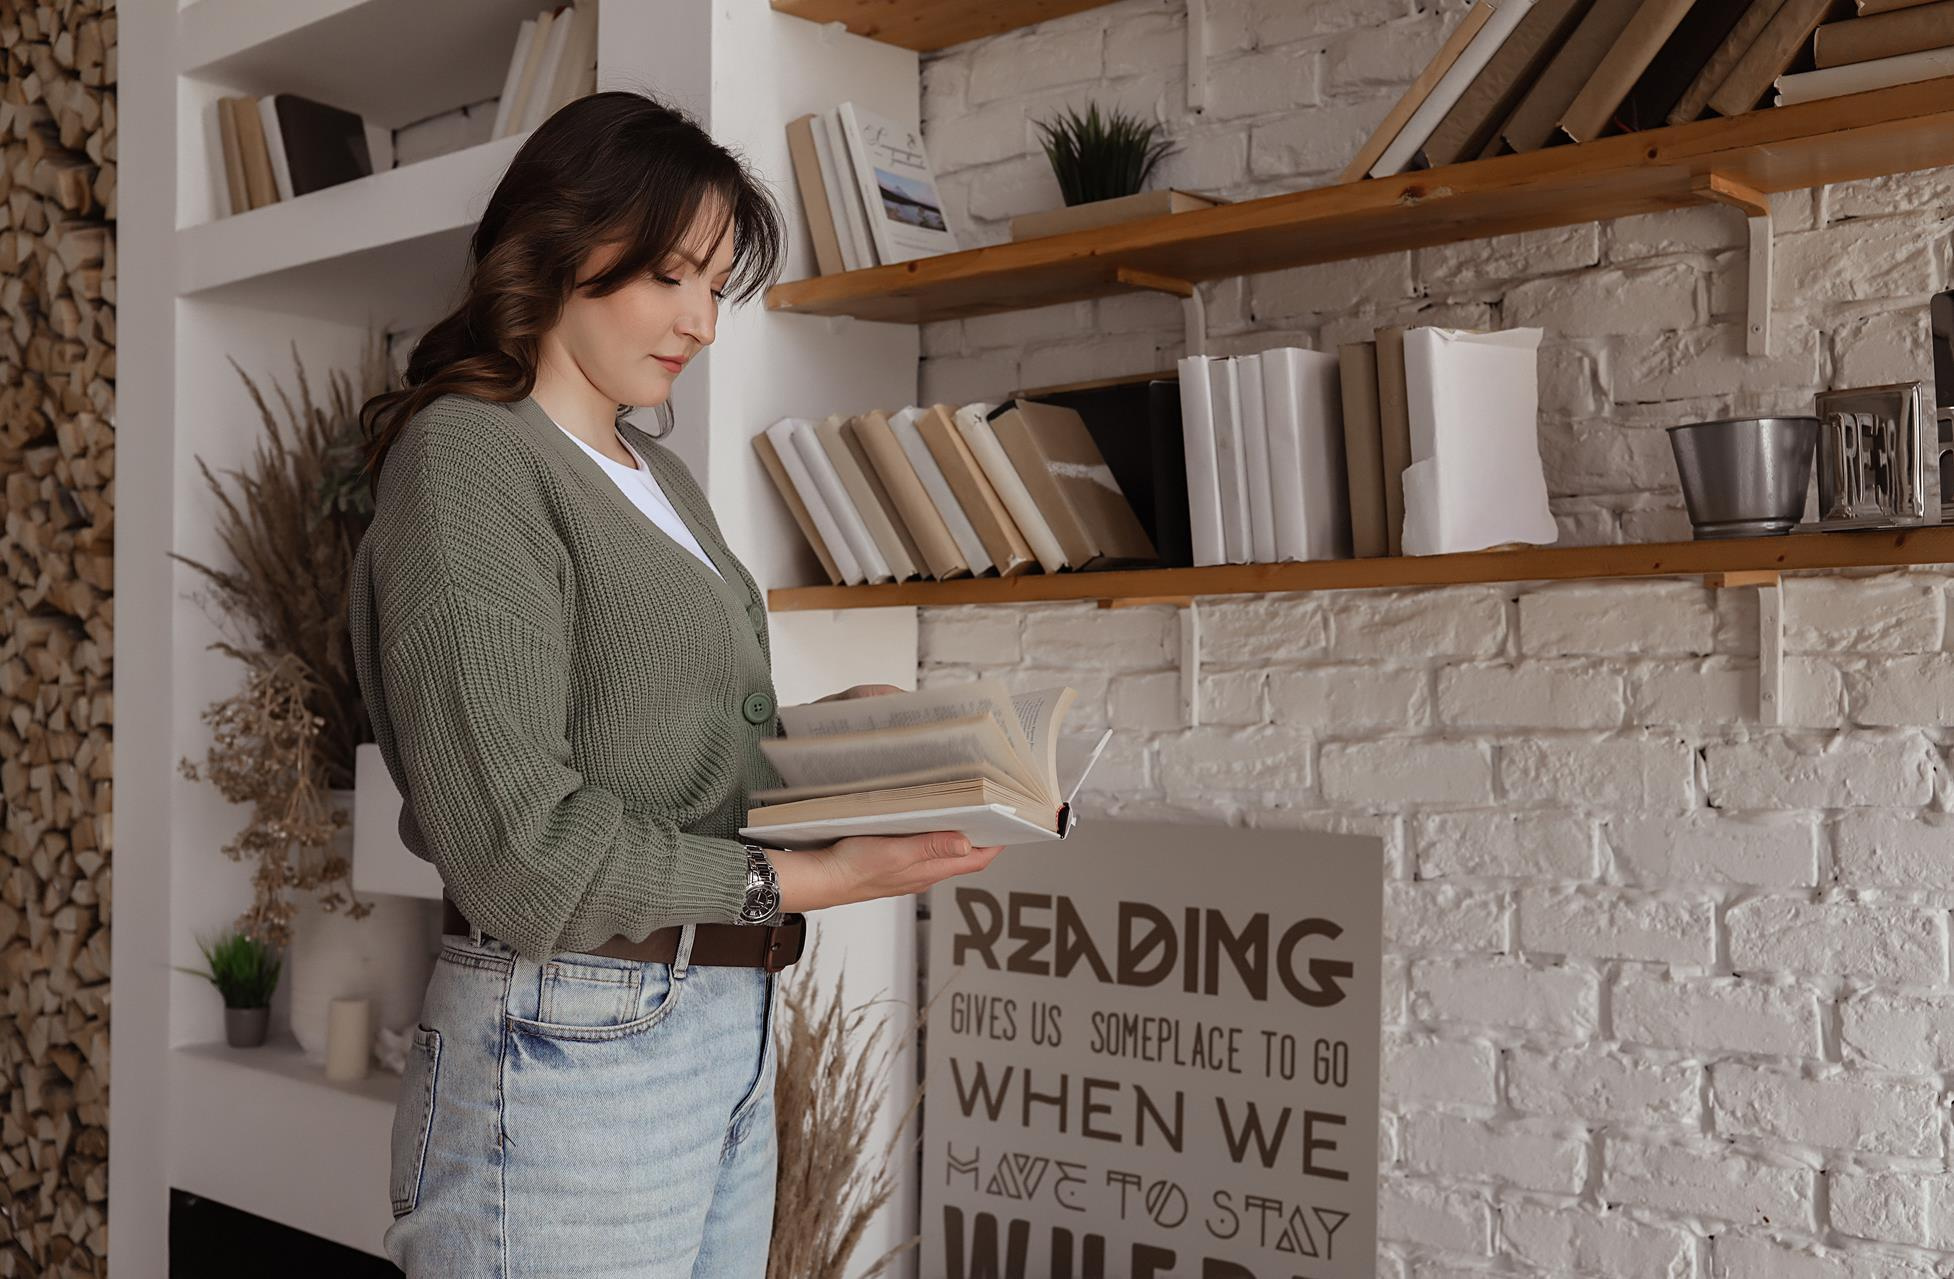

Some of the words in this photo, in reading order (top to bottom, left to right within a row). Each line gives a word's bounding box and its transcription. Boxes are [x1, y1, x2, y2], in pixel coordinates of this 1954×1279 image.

[952, 886, 1354, 1008] READING
[950, 991, 1017, 1042] GIVES
[1031, 1001, 1063, 1048] US
[1090, 1010, 1243, 1075] SOMEPLACE
[1260, 1029, 1296, 1081] TO
[1313, 1037, 1349, 1088] GO
[949, 1057, 1185, 1154] WHEN
[1215, 1096, 1350, 1182] WE
[946, 1141, 1087, 1213] HAVE
[1106, 1169, 1189, 1229] TO
[1205, 1188, 1351, 1261] STAY
